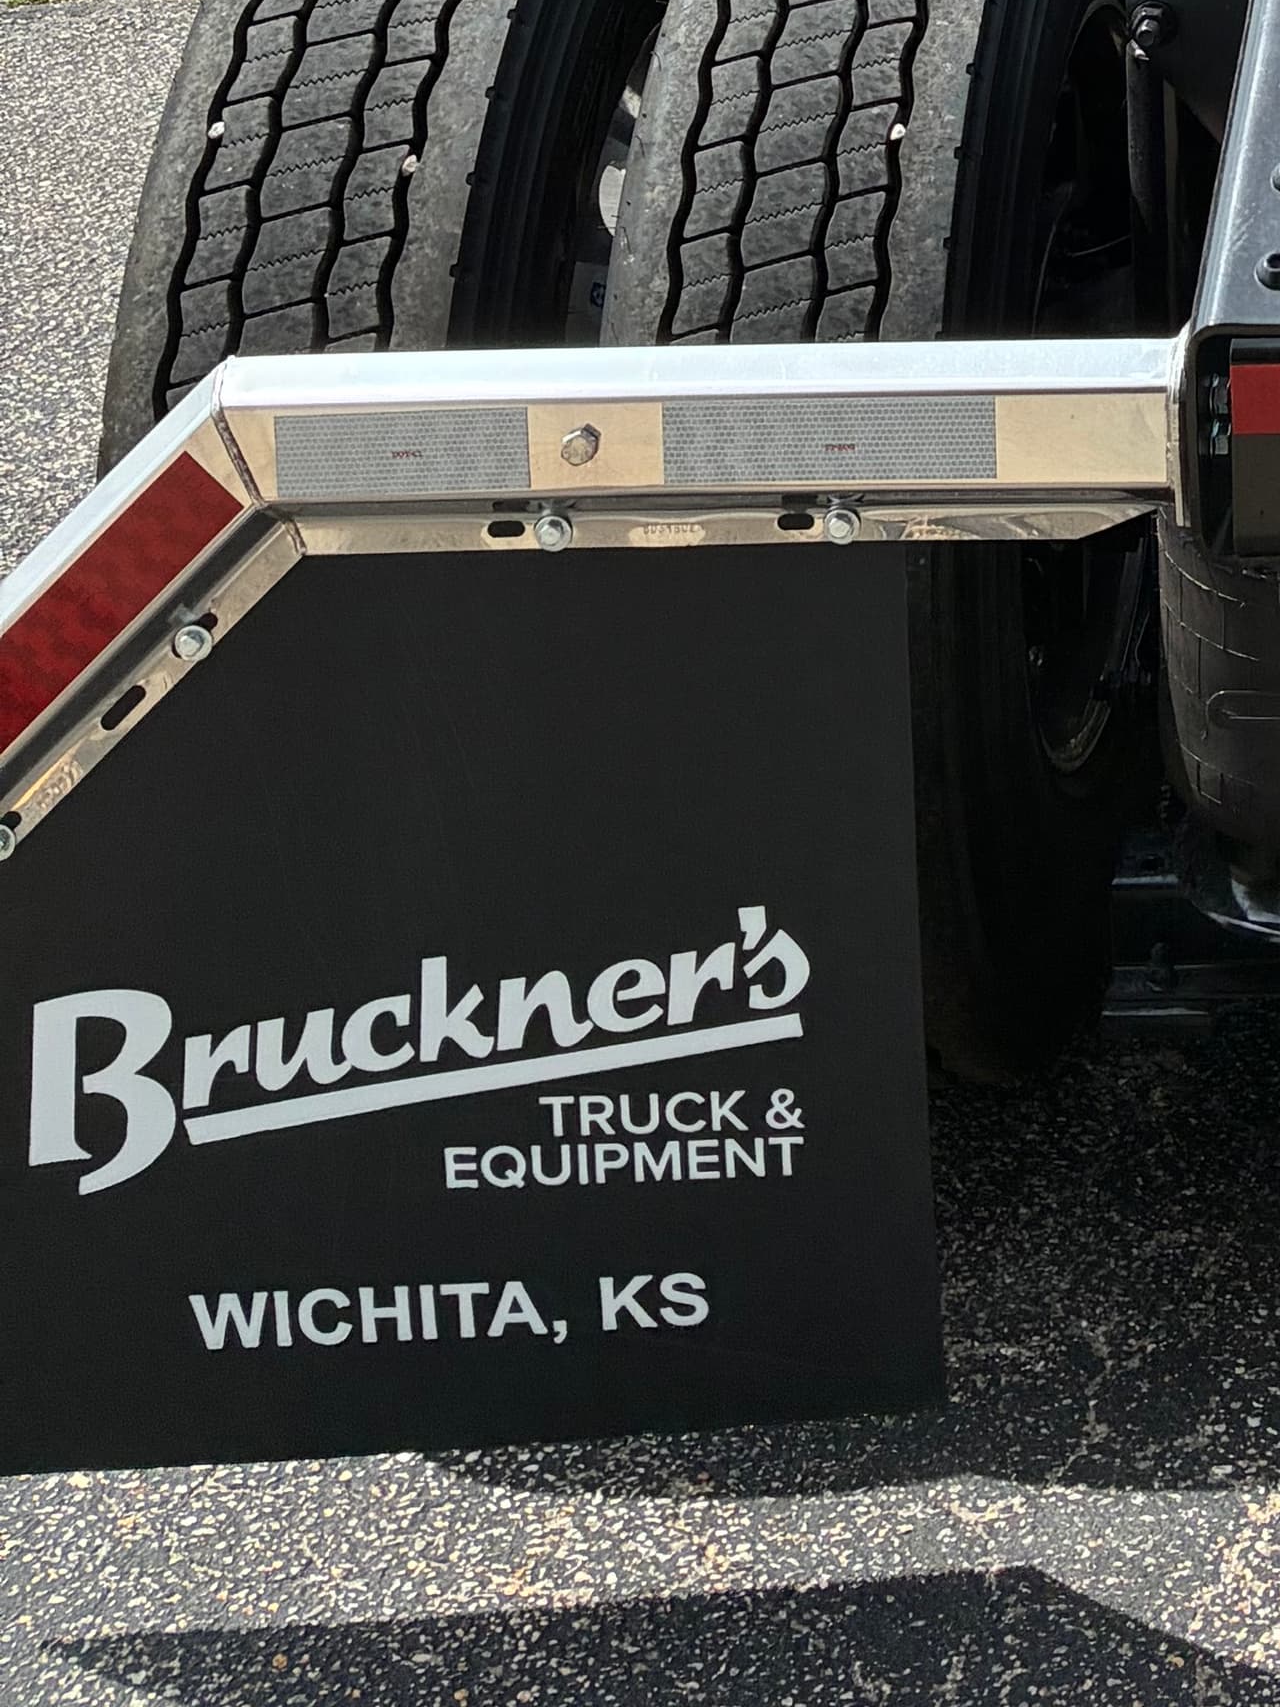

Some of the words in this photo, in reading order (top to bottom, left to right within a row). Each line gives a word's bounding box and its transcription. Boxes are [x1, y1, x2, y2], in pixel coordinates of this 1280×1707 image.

[28, 905, 811, 1196] Bruckner's
[538, 1089, 749, 1137] TRUCK
[765, 1088, 805, 1130] &
[443, 1136, 804, 1189] EQUIPMENT
[188, 1281, 569, 1350] WICHITA,
[599, 1272, 709, 1331] KS
